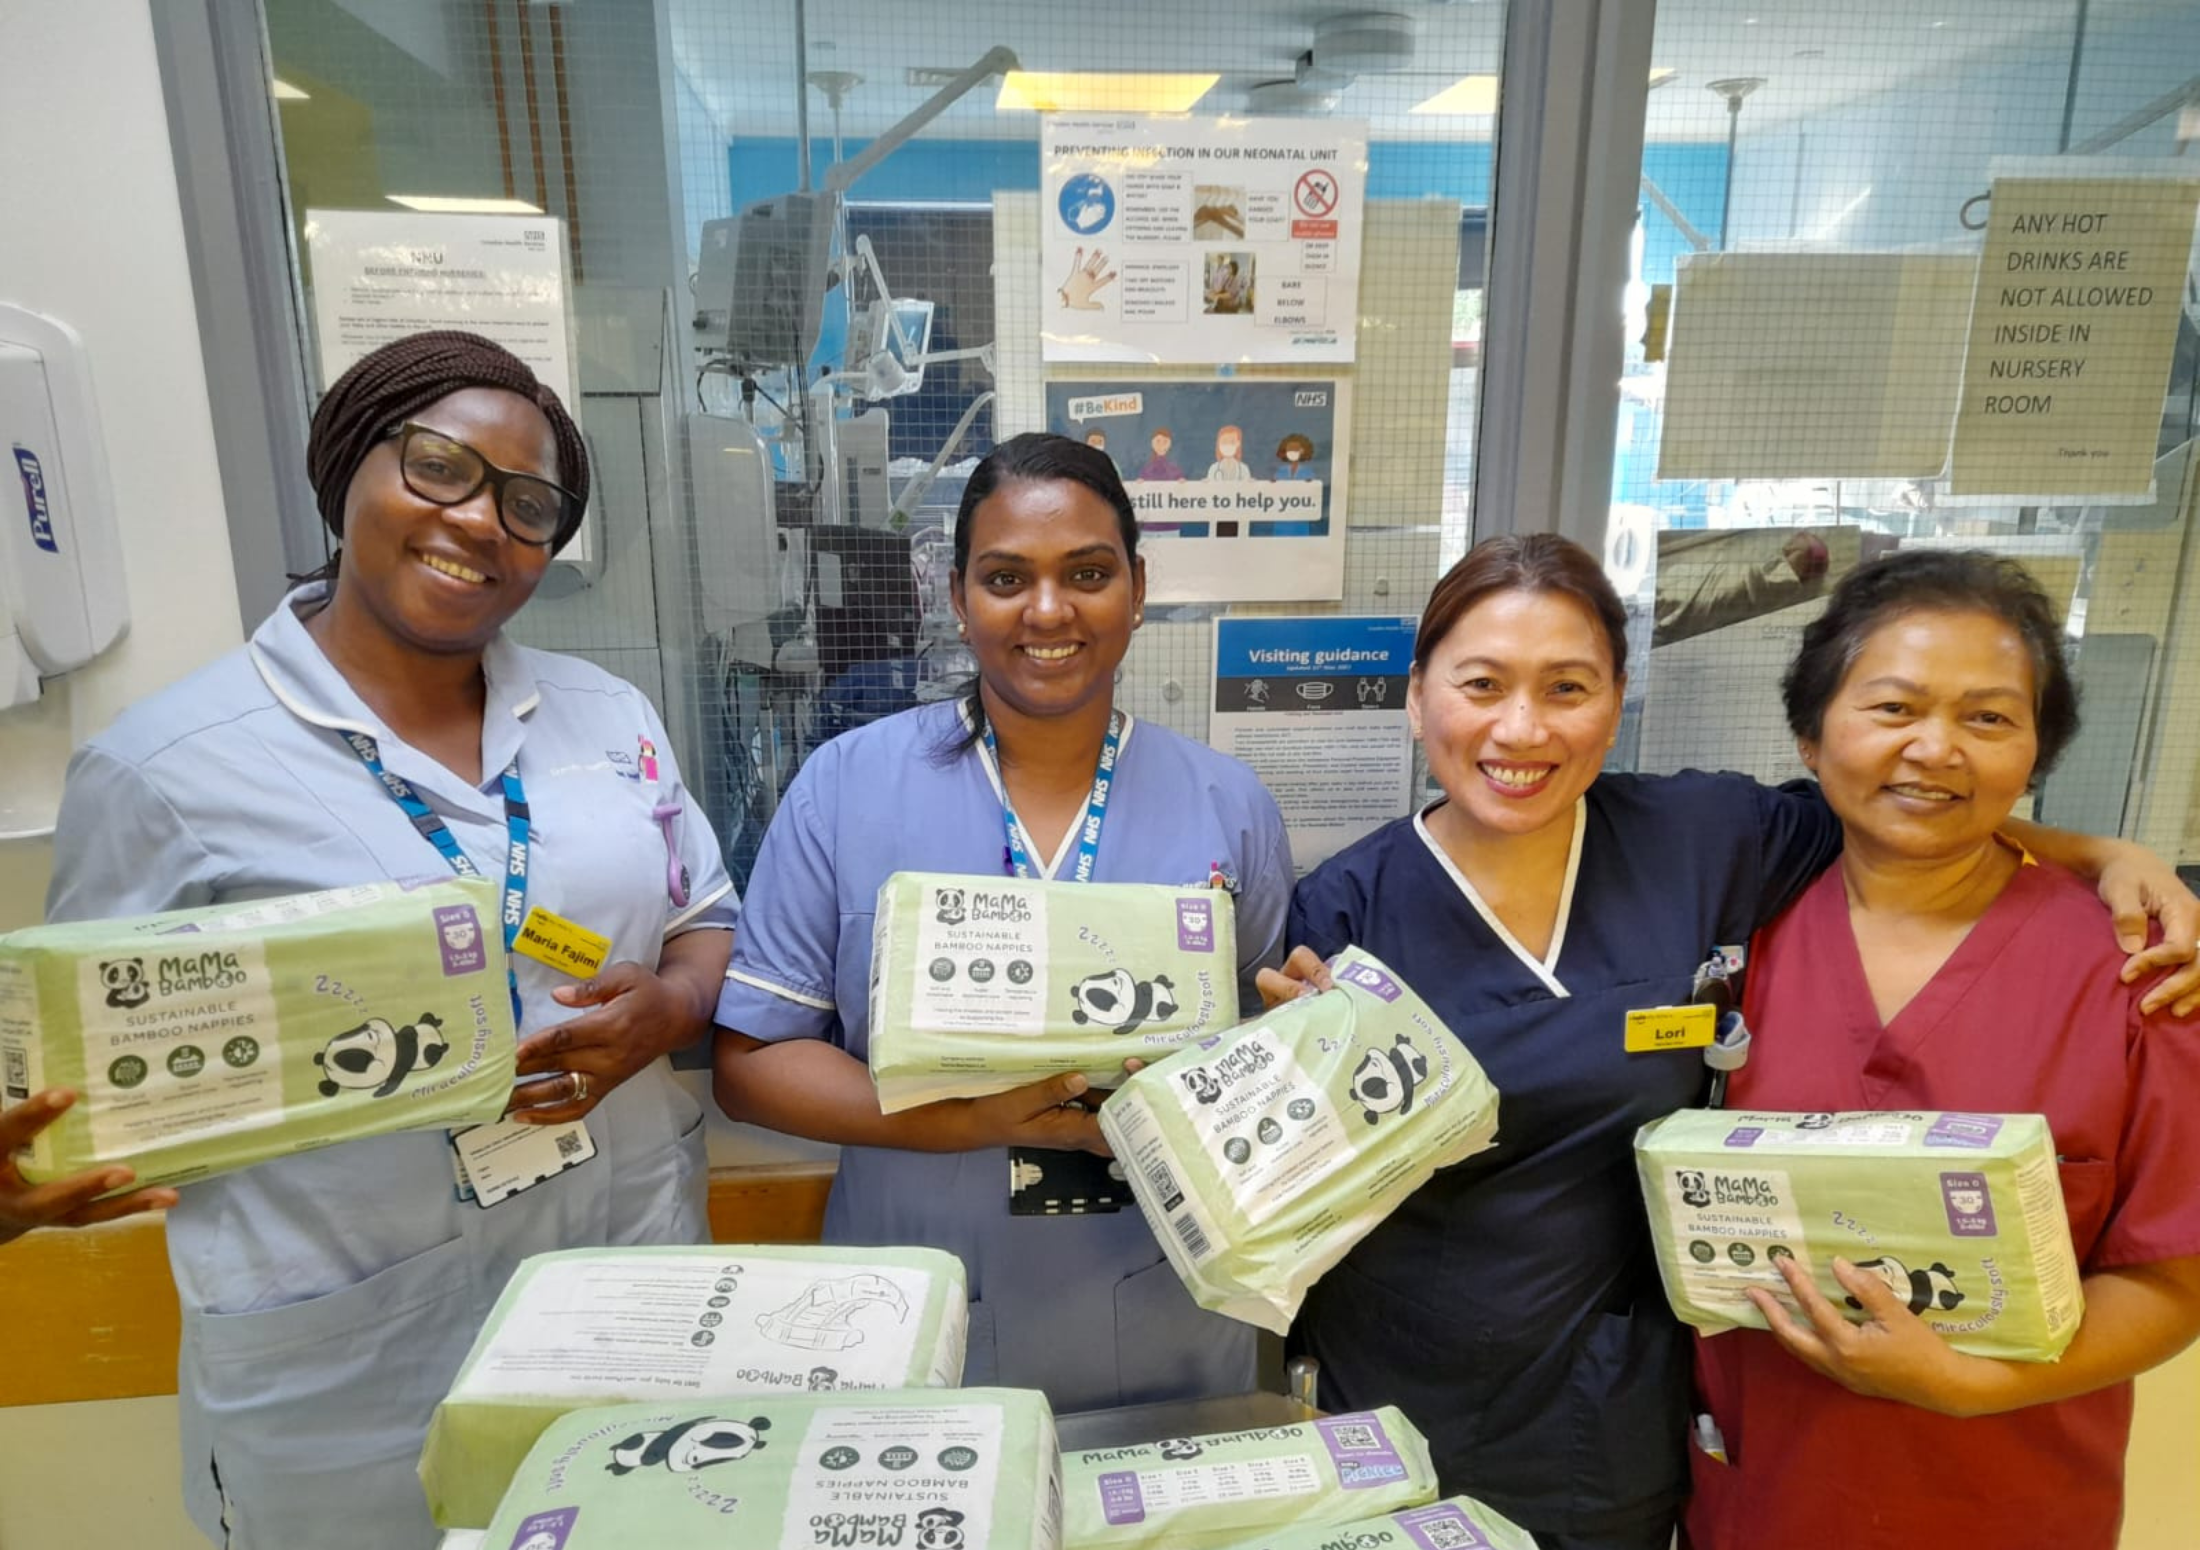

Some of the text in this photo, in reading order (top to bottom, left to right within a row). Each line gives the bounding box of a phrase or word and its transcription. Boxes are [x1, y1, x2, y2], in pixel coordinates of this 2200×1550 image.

[1054, 145, 1130, 158] PREVENTING
[1200, 148, 1211, 159] IN
[1214, 148, 1240, 159] OUR
[1243, 148, 1307, 160] NEONATAL
[1310, 149, 1338, 161] UNIT
[2011, 213, 2108, 234] ANY HOT
[2007, 251, 2130, 272] DRINKS ARE
[1281, 281, 1302, 290] BARE
[1277, 299, 1305, 308] BELOW
[2000, 287, 2153, 308] NOT ALLOWED
[1274, 316, 1307, 325] ELBOWS
[1994, 324, 2091, 344] INSIDE IN
[1990, 359, 2085, 379] NURSERY
[1073, 396, 1138, 416] #BeKind
[1296, 392, 1327, 406] NHS
[1984, 395, 2052, 414] ROOM
[2058, 448, 2110, 460] Thank you
[21, 457, 51, 541] Purell
[1129, 492, 1316, 512] still here to help you.
[1249, 648, 1389, 665] Visiting guidance
[350, 733, 379, 762] NHS
[1099, 744, 1116, 771] NHS
[378, 769, 411, 797] NHS
[1091, 778, 1109, 808] NHS
[1009, 823, 1024, 853] NHS
[1083, 814, 1101, 845] NHS
[509, 841, 526, 877] NHS
[1075, 852, 1093, 882] NHS
[504, 889, 523, 926] NHS
[947, 930, 1021, 941] SUSTAINABLE
[522, 927, 559, 951] Maria
[561, 944, 600, 969] Fajimi
[934, 941, 1033, 953] BAMBOO NAPPIES
[126, 1001, 238, 1028] SUSTAINABLE
[110, 1014, 255, 1047] BAMBOO NAPPIES
[1655, 1027, 1686, 1040] Lori
[1215, 1073, 1282, 1116] SUSTAINABLE
[1213, 1081, 1297, 1134] BAMBOO NAPPIES
[1946, 1179, 1970, 1187] Size
[1696, 1213, 1774, 1225] SUSTAINABLE
[1688, 1224, 1788, 1240] BAMBOO NAPPIES
[1931, 1257, 2008, 1333] Miraculously soft
[815, 1478, 969, 1489] BAMBOO NAPPIES
[829, 1490, 949, 1502] SUSTAINABLE
